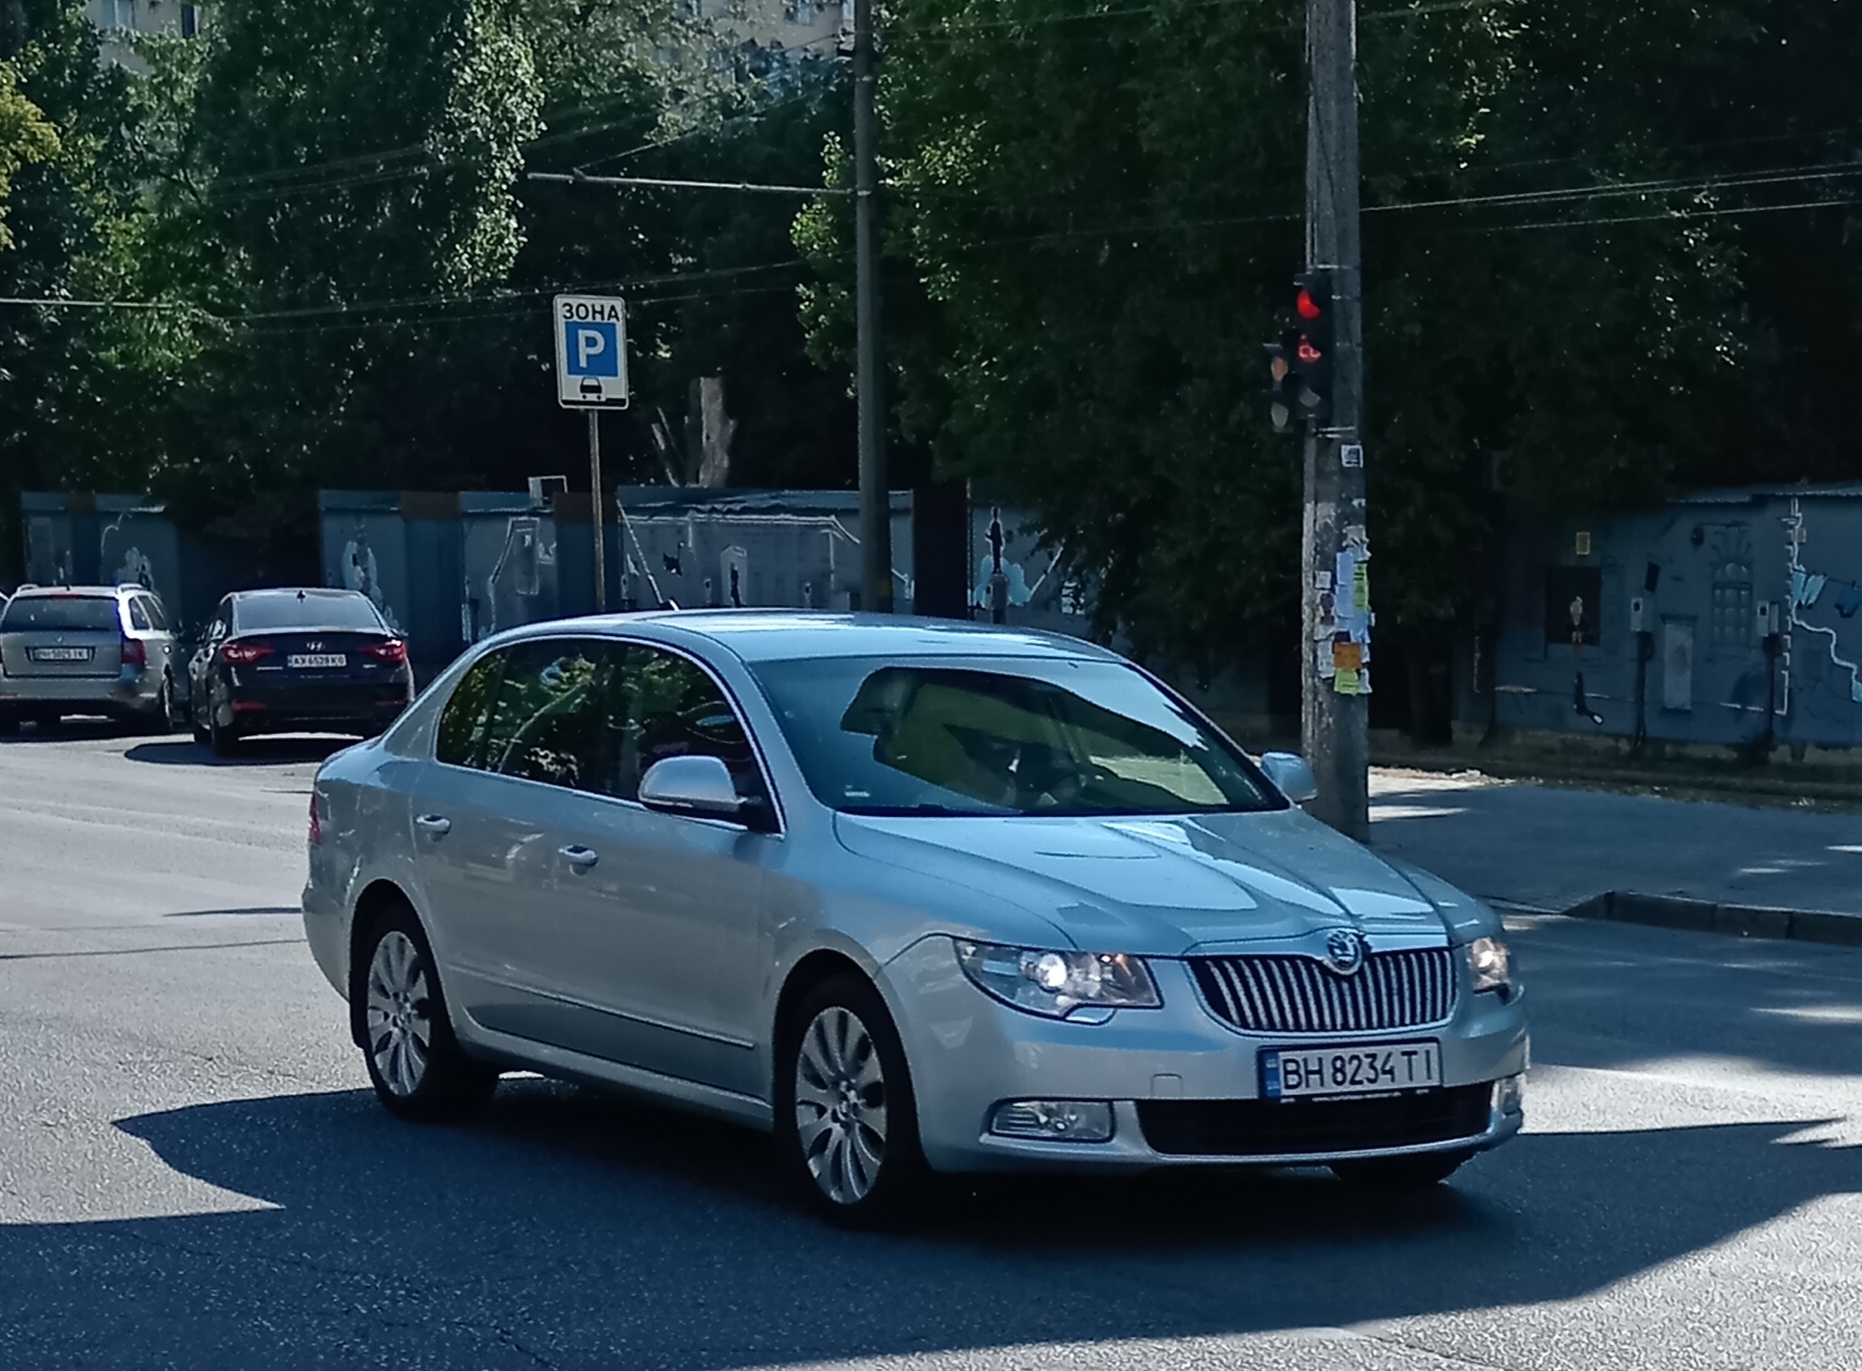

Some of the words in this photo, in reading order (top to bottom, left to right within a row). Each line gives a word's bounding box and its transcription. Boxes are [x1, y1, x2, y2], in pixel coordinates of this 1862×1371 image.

[562, 303, 620, 322] ЗОНА
[578, 329, 605, 368] P
[1282, 1057, 1325, 1090] BH
[1331, 1052, 1396, 1087] 8234
[1401, 1050, 1432, 1082] TI
